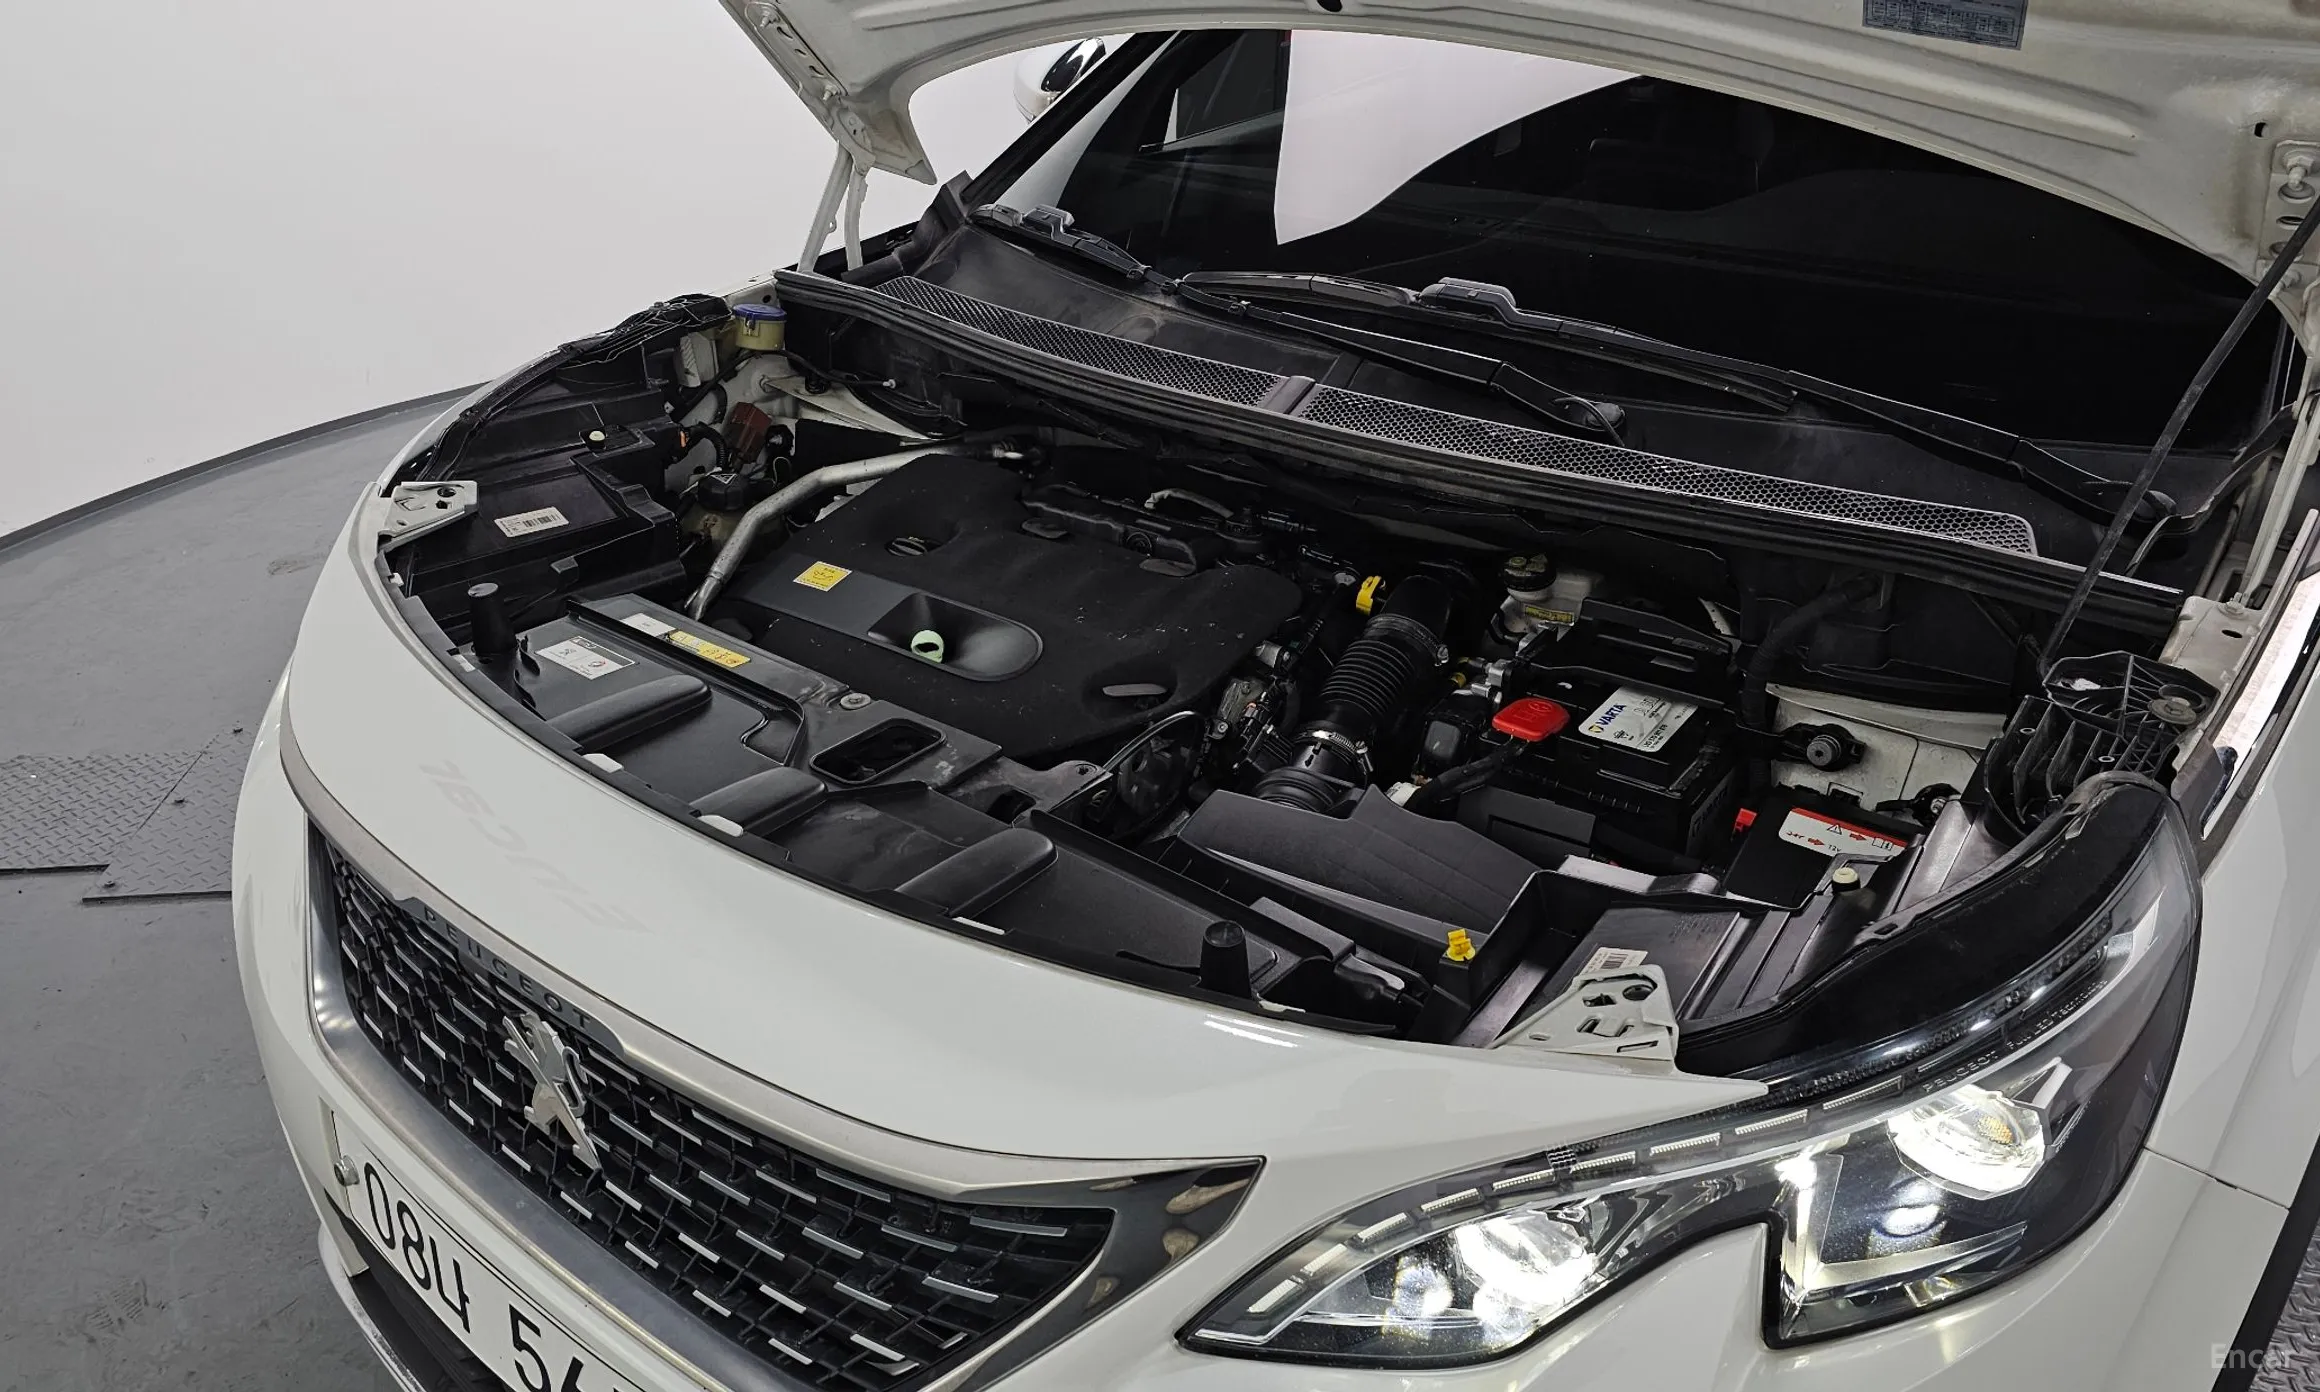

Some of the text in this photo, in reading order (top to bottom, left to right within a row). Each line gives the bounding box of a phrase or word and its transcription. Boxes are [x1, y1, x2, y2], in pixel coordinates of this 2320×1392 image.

[1595, 703, 1627, 726] VARTA
[424, 907, 591, 1029] PEUGEOT
[1922, 1050, 1999, 1093] PEUGEOT
[364, 1162, 470, 1333] 08나
